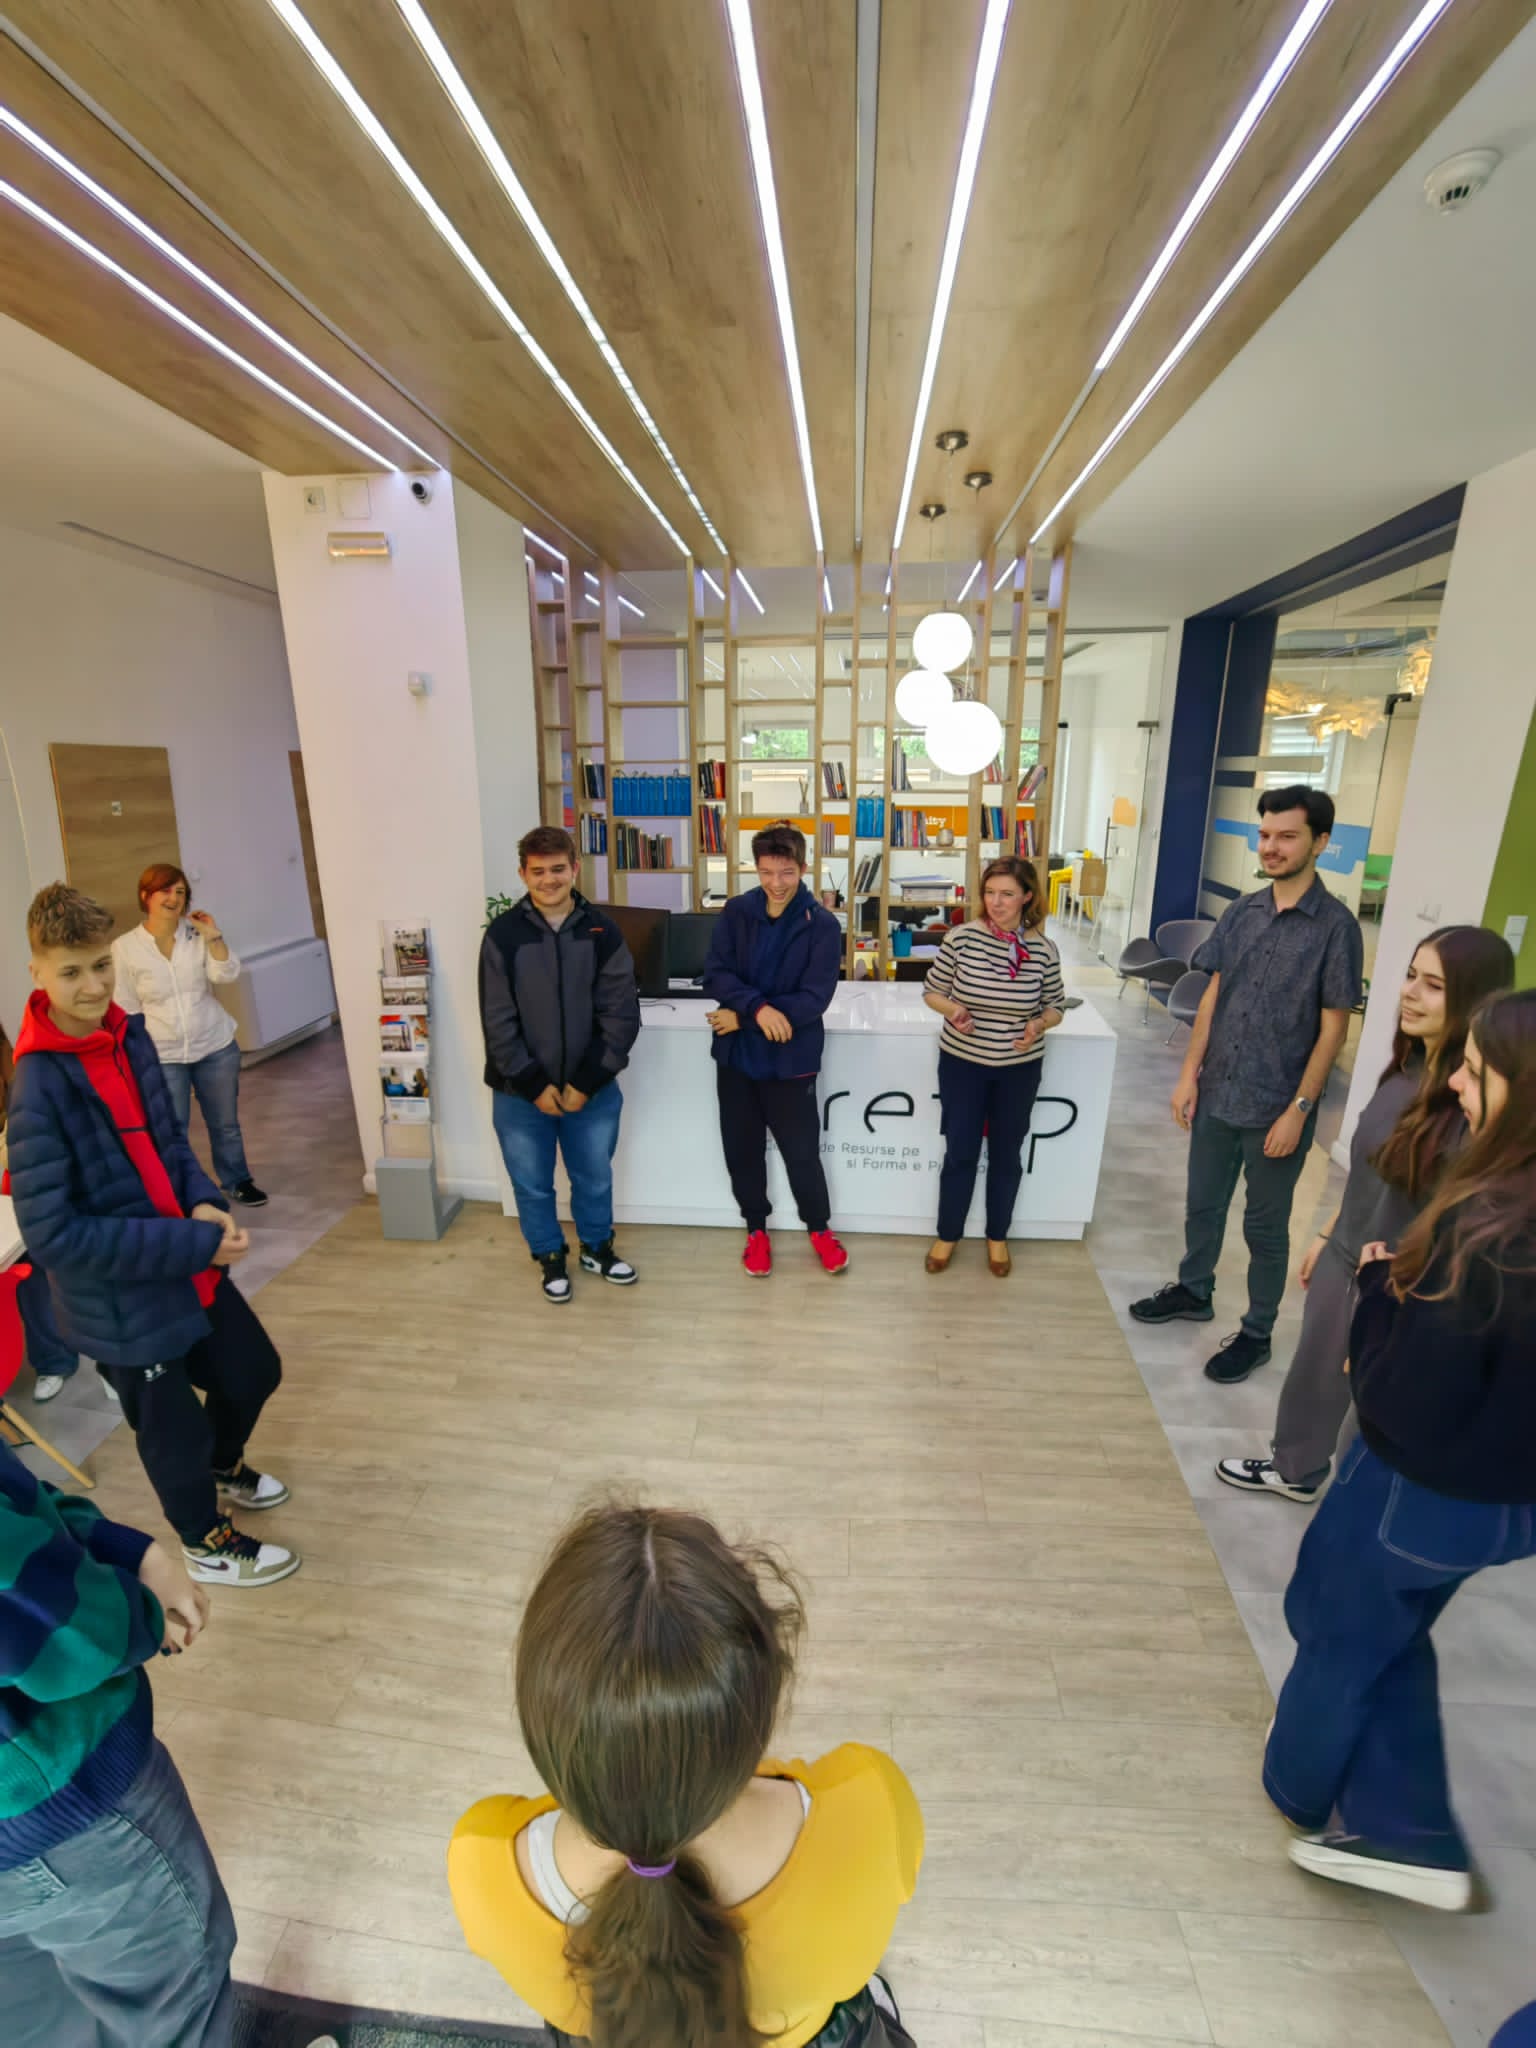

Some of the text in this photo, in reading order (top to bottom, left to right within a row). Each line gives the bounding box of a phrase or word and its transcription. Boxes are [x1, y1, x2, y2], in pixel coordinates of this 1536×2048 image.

[819, 1141, 920, 1158] de Resurse pe
[863, 1158, 907, 1171] Forma
